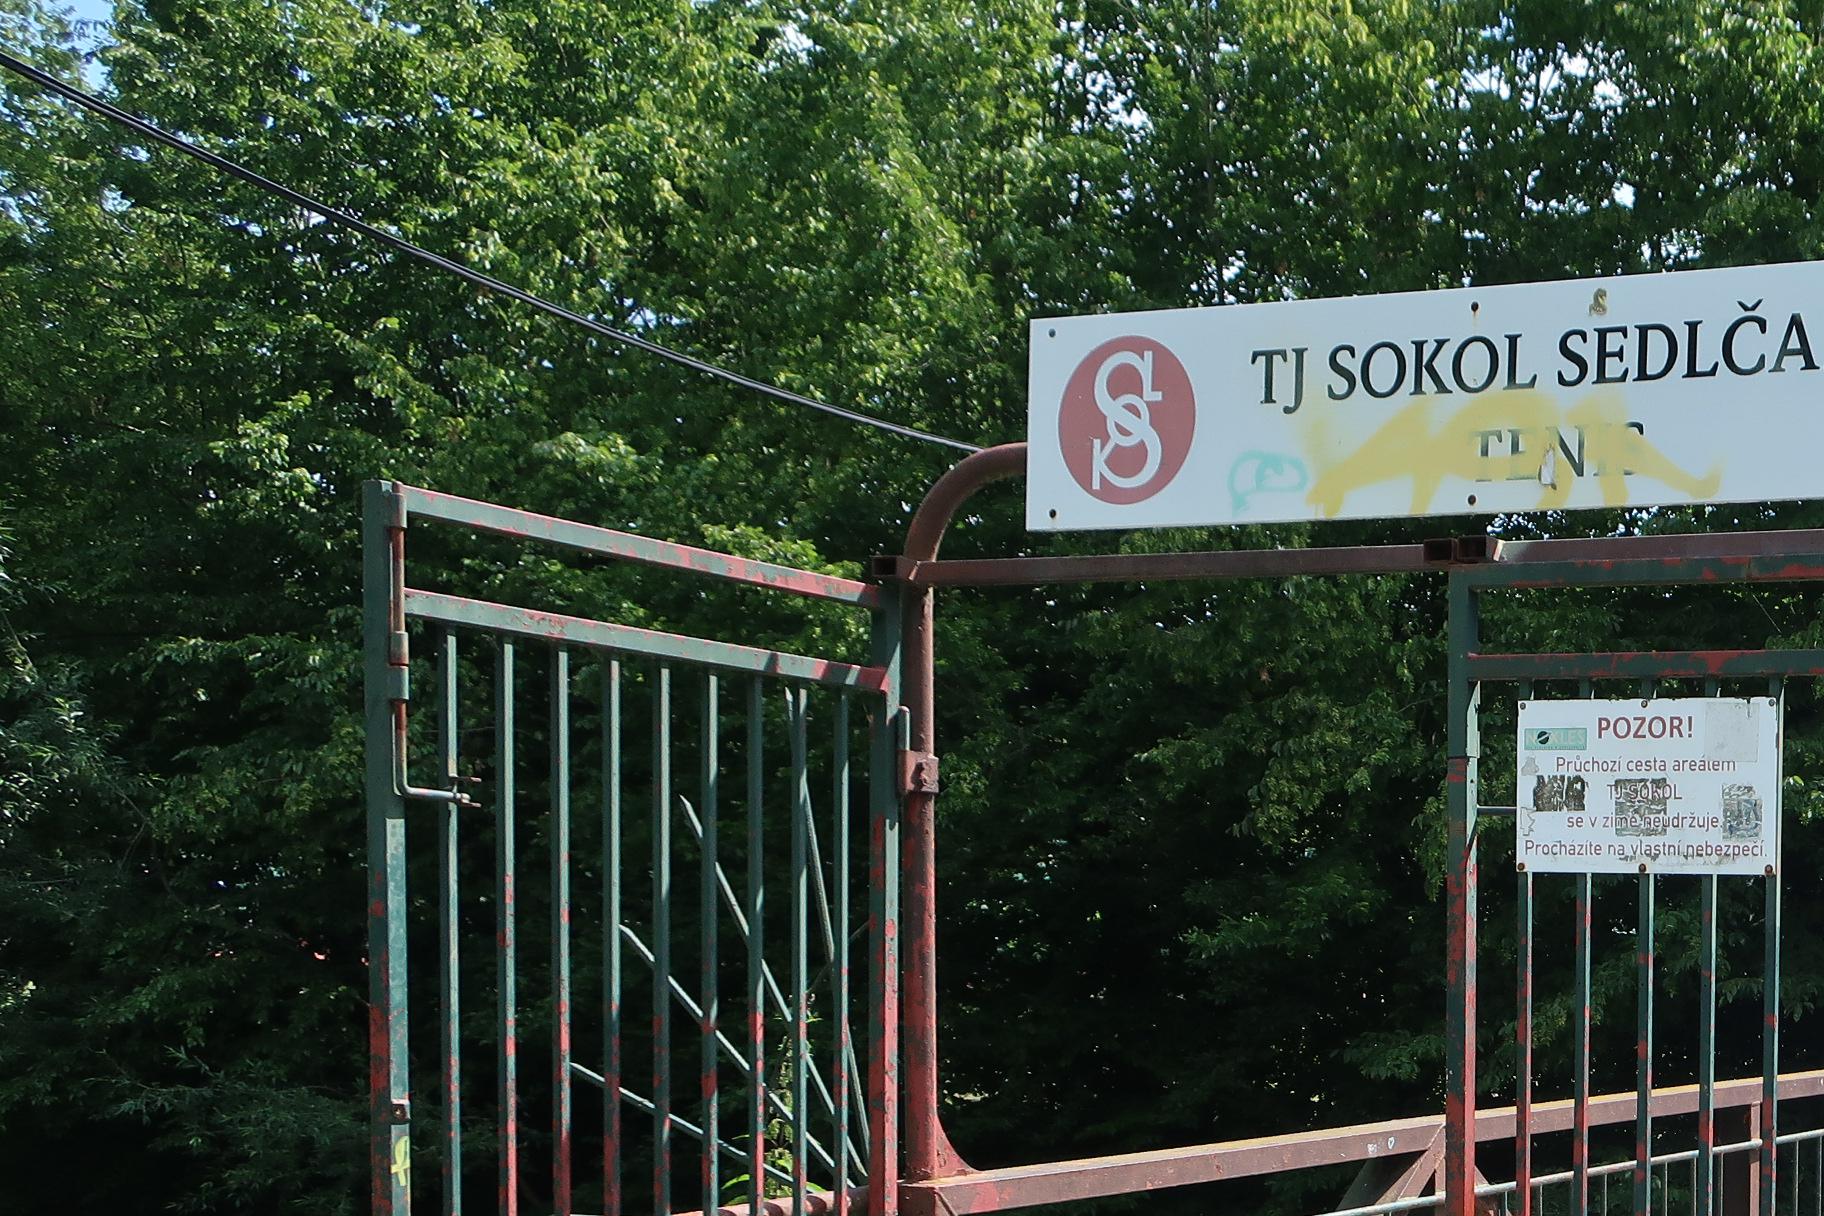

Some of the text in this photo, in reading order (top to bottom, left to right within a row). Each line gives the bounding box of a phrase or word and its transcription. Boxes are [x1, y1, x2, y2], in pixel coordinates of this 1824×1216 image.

[1251, 347, 1308, 415] TJ
[1327, 334, 1537, 400] SOKOL
[1598, 716, 1693, 739] POZOR!
[1556, 754, 1736, 772] Průchozí cesta areálem
[1607, 783, 1683, 800] TJ SOKOL
[1567, 811, 1723, 832] se v zimě neudržuje.
[1525, 838, 1768, 860] Procházíte na vlastní nebezpečí.
